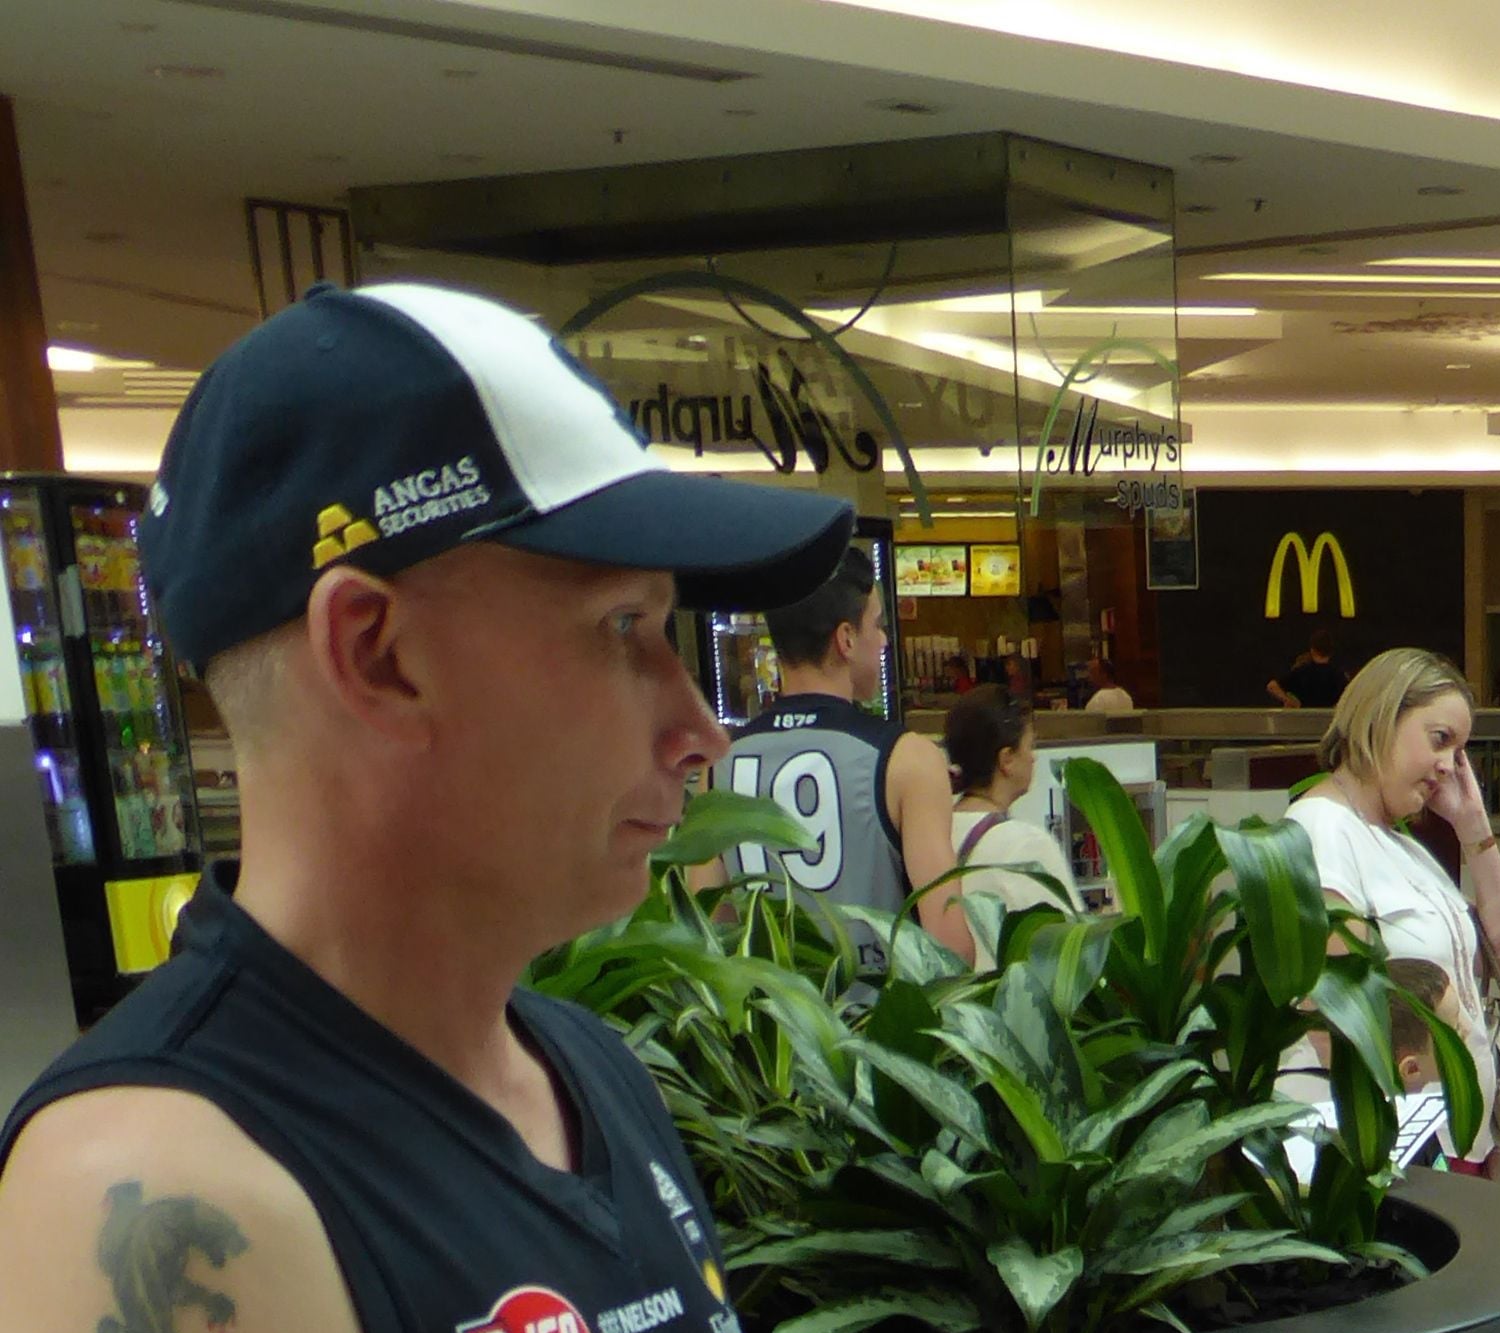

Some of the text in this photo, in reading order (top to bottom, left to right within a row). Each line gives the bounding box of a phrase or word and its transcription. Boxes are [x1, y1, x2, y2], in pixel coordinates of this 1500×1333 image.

[1046, 396, 1178, 477] Murphy's
[1116, 475, 1181, 521] spuds
[731, 749, 845, 893] 19
